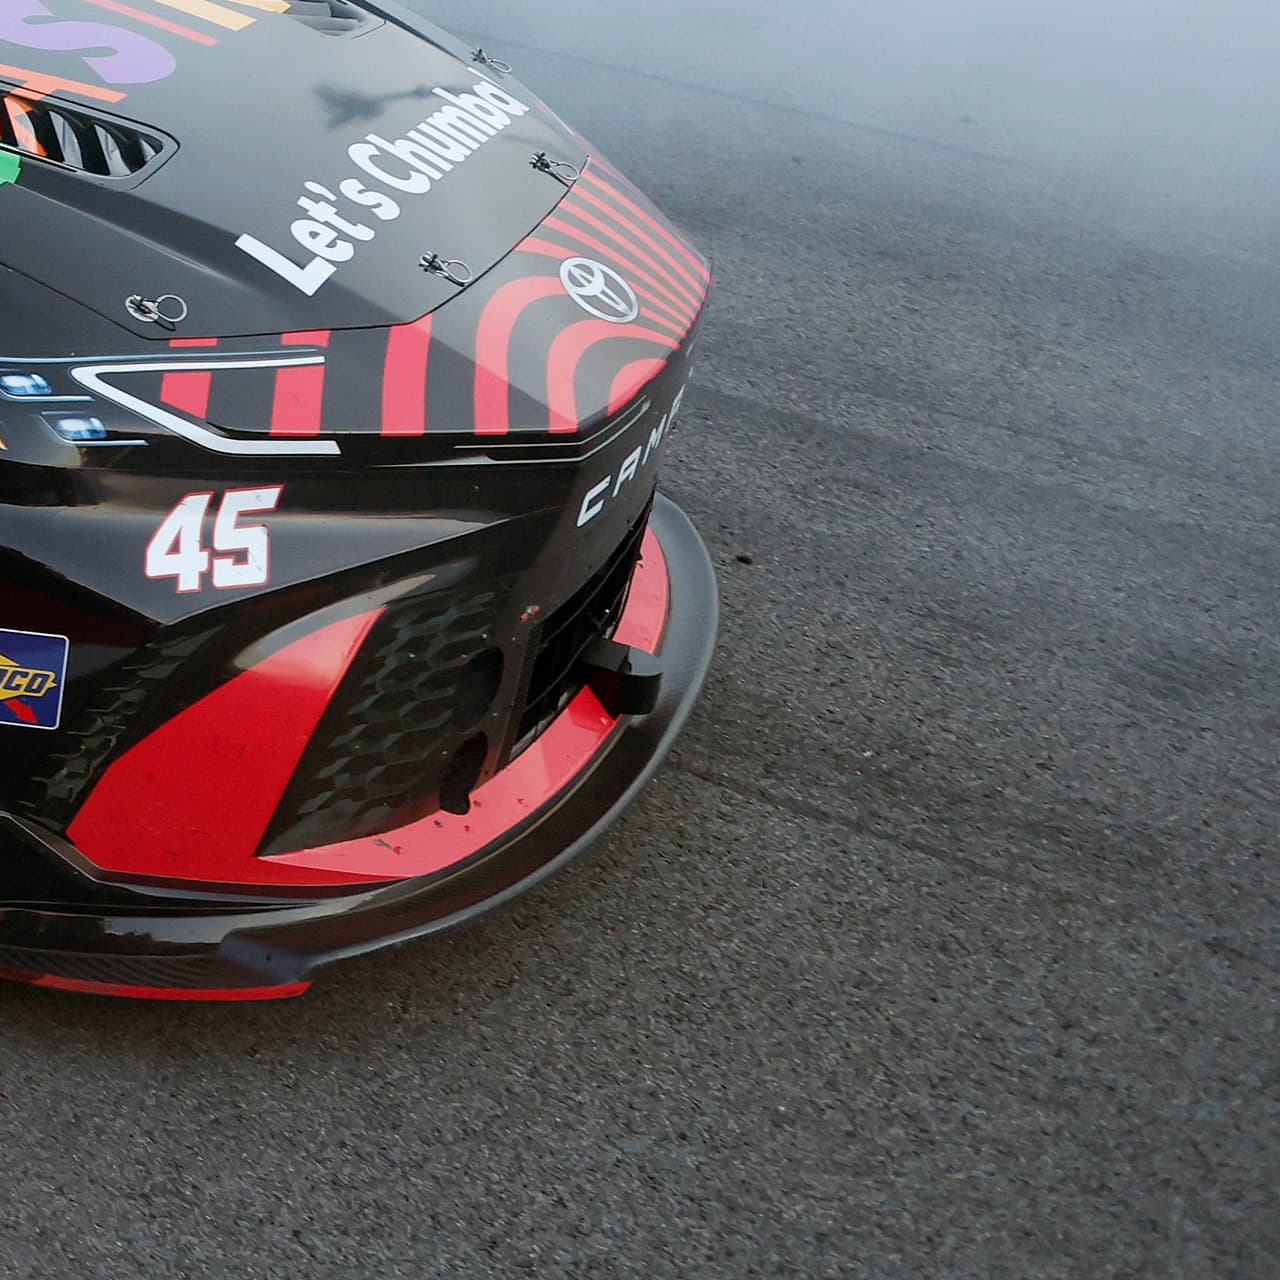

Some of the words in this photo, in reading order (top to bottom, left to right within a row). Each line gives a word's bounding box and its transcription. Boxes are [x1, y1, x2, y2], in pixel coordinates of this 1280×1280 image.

[234, 180, 401, 297] Let's
[347, 80, 530, 195] Chumba
[576, 365, 694, 528] CAMR
[144, 483, 285, 594] 45
